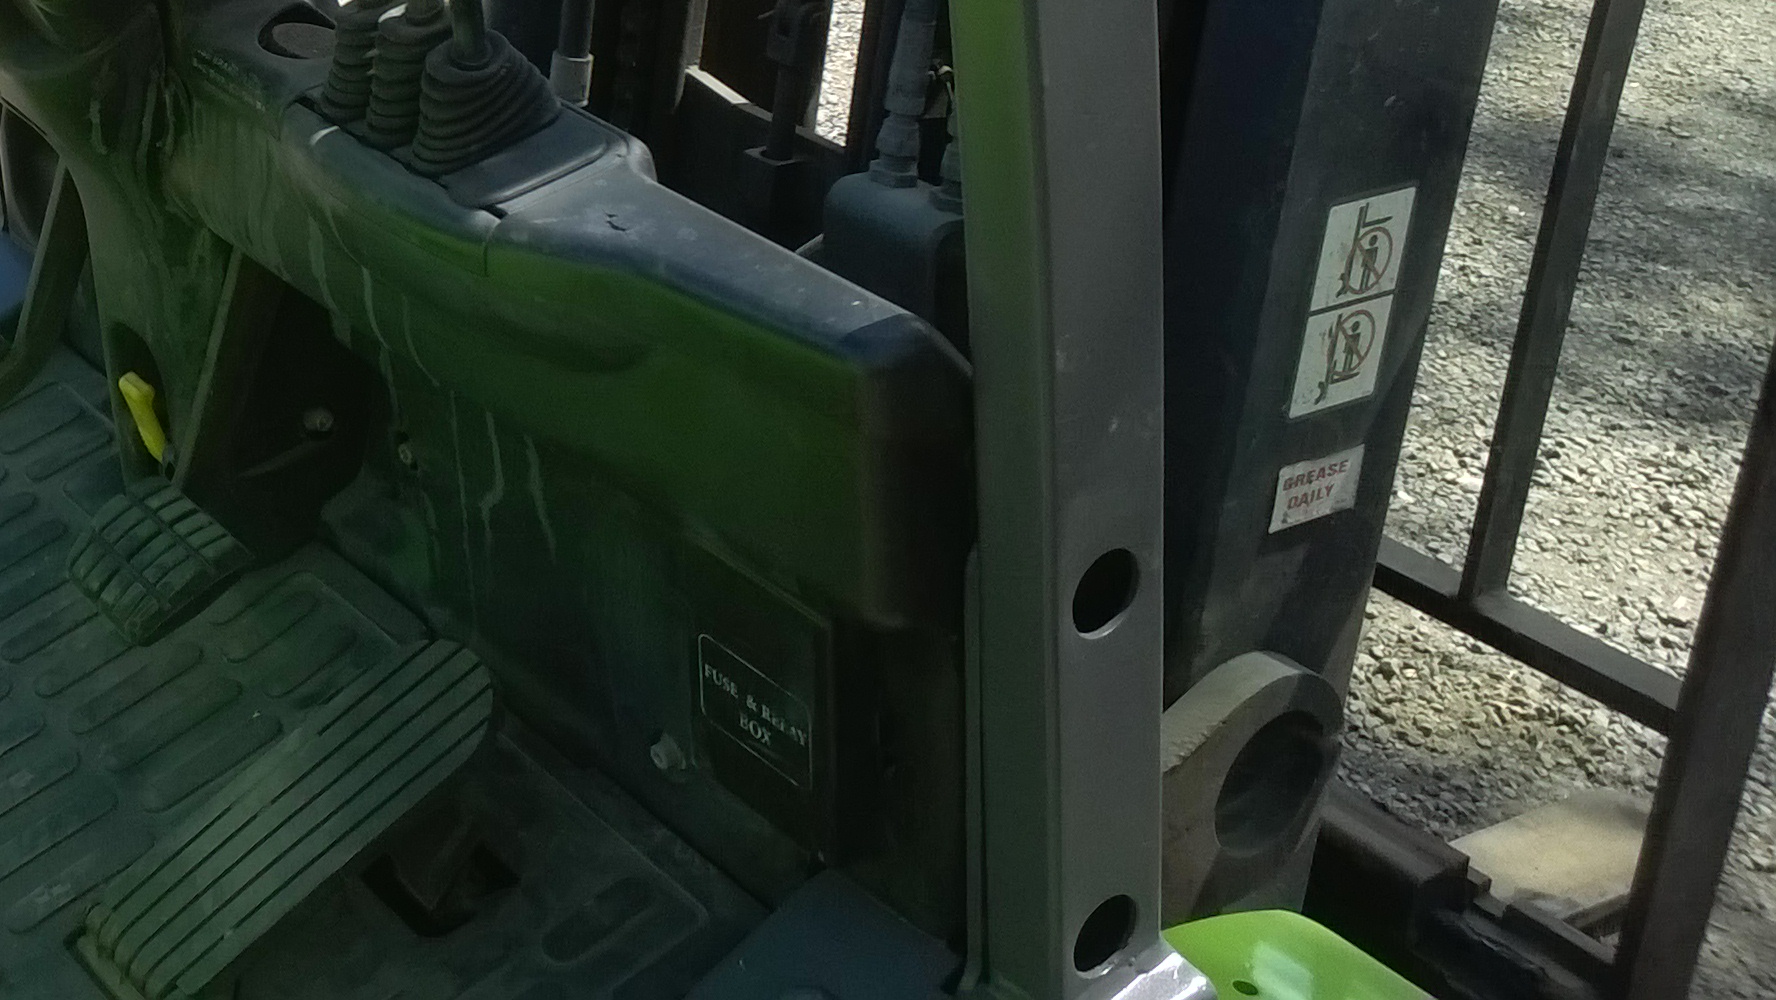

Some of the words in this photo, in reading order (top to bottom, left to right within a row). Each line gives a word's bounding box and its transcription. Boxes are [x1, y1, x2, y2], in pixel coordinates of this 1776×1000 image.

[1283, 460, 1348, 491] GREASE
[1287, 483, 1335, 510] DAILY
[704, 664, 738, 698] FUSE
[746, 695, 757, 712] &
[740, 713, 771, 746] BOX
